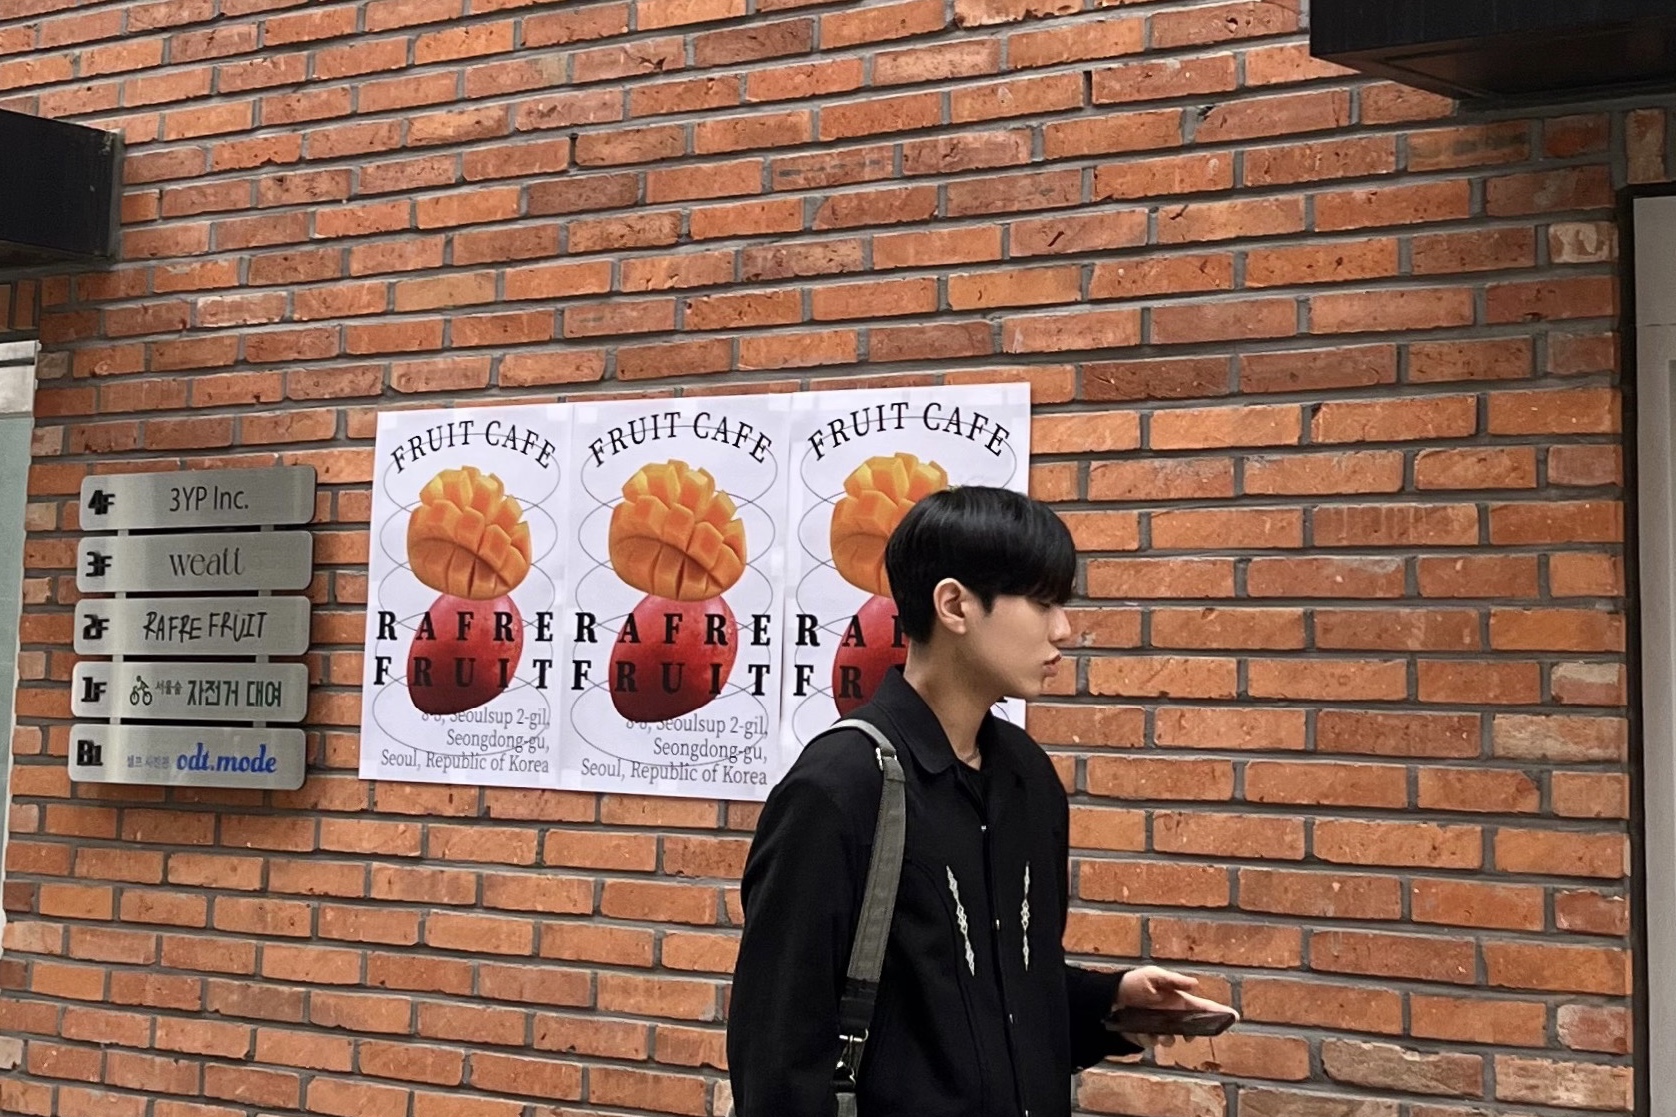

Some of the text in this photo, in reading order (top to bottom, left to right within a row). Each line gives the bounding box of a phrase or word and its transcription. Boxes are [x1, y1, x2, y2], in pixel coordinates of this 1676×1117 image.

[588, 411, 772, 468] FRUIT CAFE
[808, 401, 1010, 461] FRUIT CAFE
[390, 420, 556, 474] FRUIT CAFE
[88, 486, 249, 515] 4F 3YP Inc.
[85, 551, 113, 577] 3F
[82, 613, 110, 640] 2F
[142, 611, 202, 643] RAFRE
[376, 610, 554, 642] RAFRE
[574, 612, 771, 646] RAFRE
[373, 655, 553, 689] FRUIT
[571, 660, 770, 696] FRUIT
[81, 676, 107, 702] 1F
[187, 680, 239, 706] 자전거
[246, 680, 282, 707] 대여
[516, 708, 550, 729] 2-gil,
[730, 714, 768, 739] 2-gil,
[76, 739, 103, 766] B1
[176, 742, 278, 773] odt.mode
[446, 728, 550, 754] Seongdong-gu,
[653, 737, 767, 763] Seongdong-gu,
[381, 749, 549, 773] Seoul, Republic of Korea
[581, 757, 767, 785] Seoul, Republic of Korea
